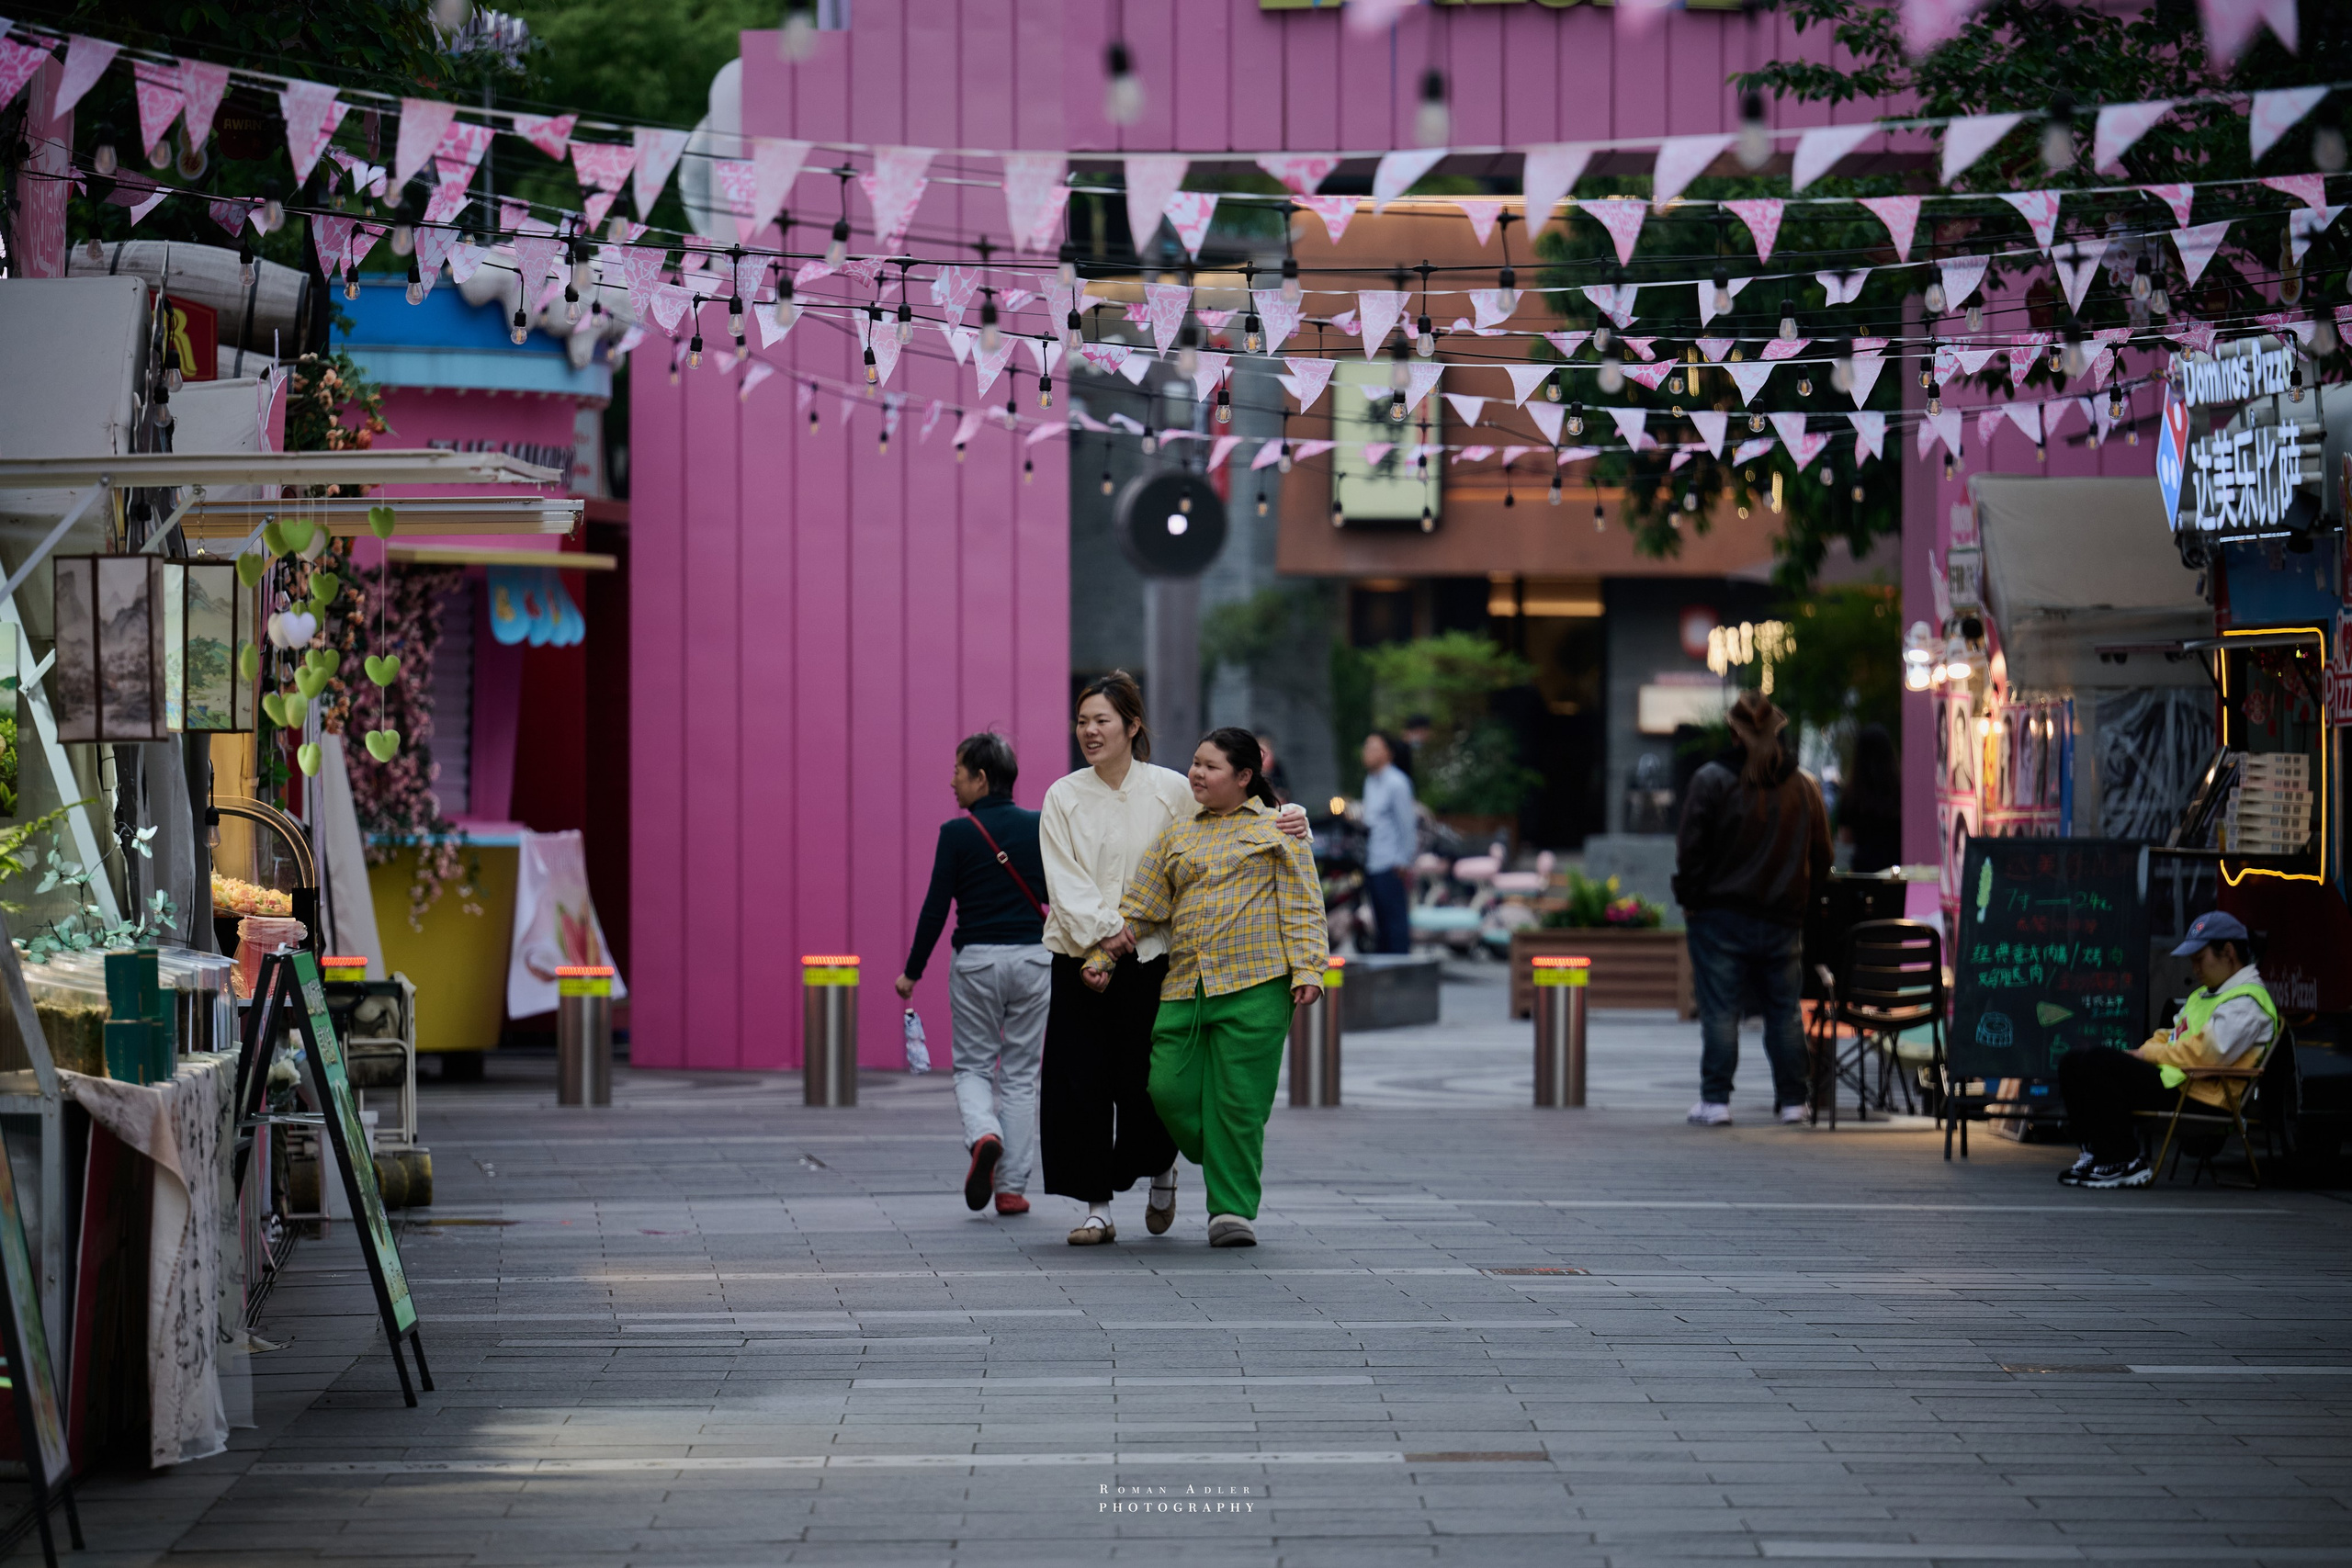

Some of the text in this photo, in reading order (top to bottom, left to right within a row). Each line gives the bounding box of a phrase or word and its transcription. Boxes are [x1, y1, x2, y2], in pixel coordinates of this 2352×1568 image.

[2251, 337, 2295, 396] Pizza
[2191, 418, 2301, 531] 达美乐比萨
[2324, 662, 2352, 720] Pizz
